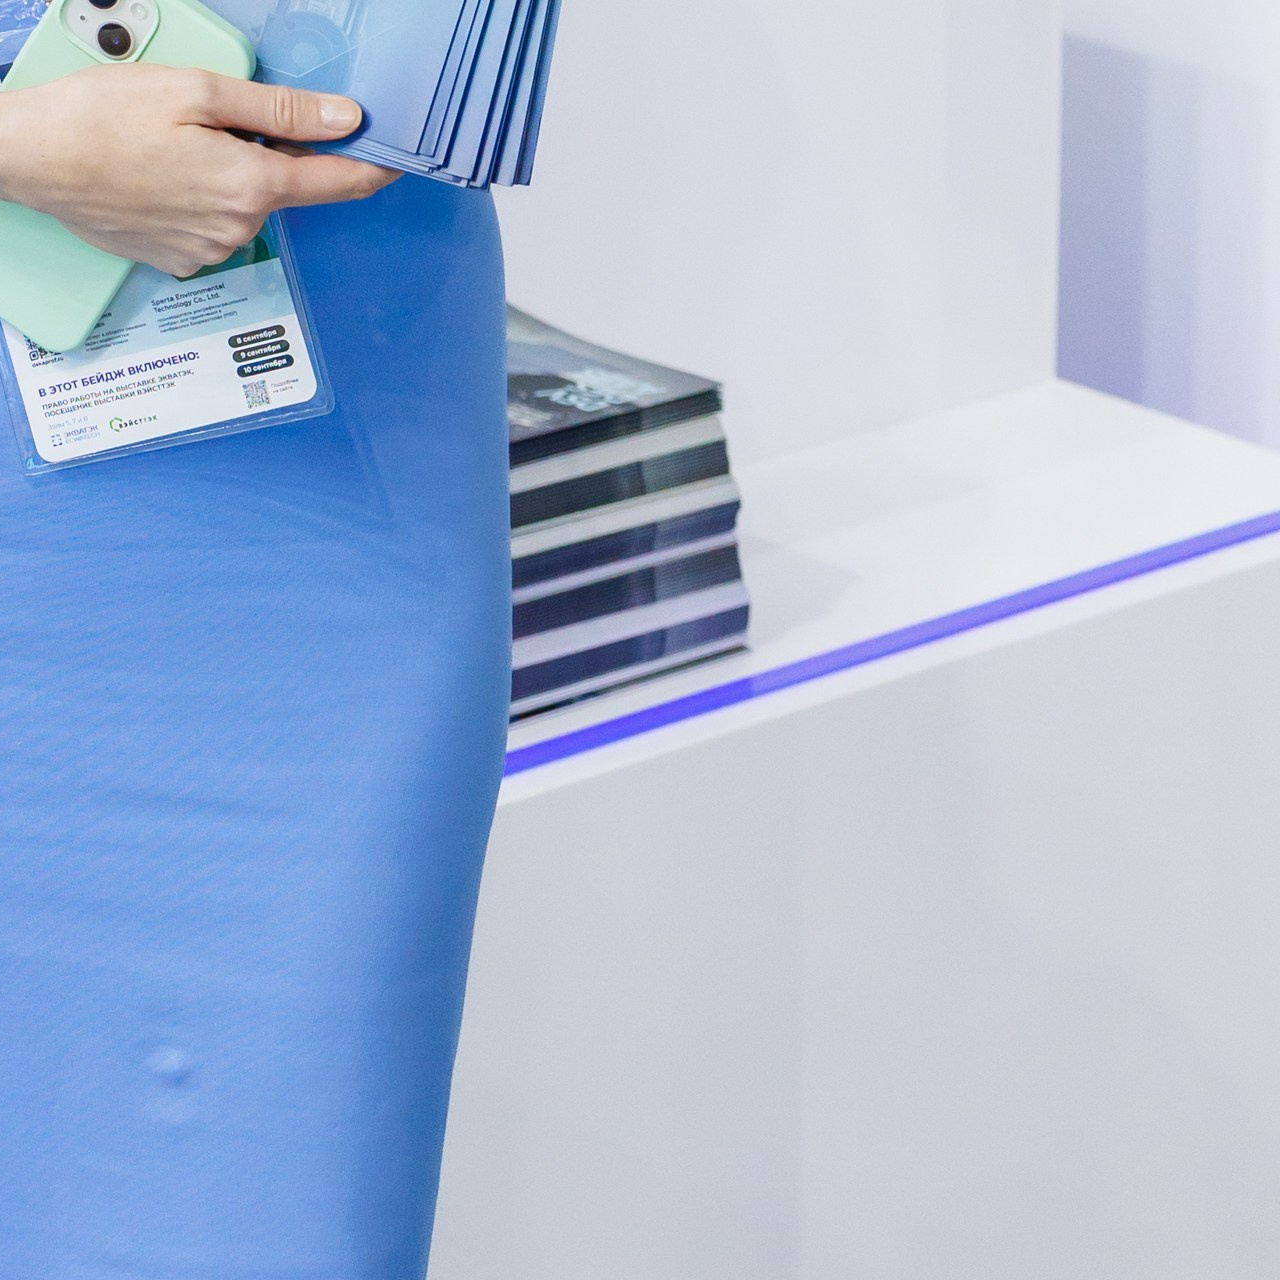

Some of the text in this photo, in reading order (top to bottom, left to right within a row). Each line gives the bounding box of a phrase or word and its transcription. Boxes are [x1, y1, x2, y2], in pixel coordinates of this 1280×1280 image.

[151, 282, 226, 307] Sperta Environmental
[153, 292, 221, 313] Technology Co., Ltd.
[243, 329, 277, 343] сентября
[247, 344, 281, 357] сентября
[38, 351, 200, 398] В ЭТОТ БЕЙДЖ ВКЛЮЧЕНО:
[244, 358, 287, 374] 10 сентября
[42, 369, 195, 410] ПРАВО РАБОТЫ НА ВЫСТАВКЕ ЭКВАТЭК,
[45, 381, 176, 418] ПОСЕЩЕНИЕ ВЫСТАВКИ ВЭЙСТТЭК
[119, 415, 158, 429] ВЭЙСТТЭК
